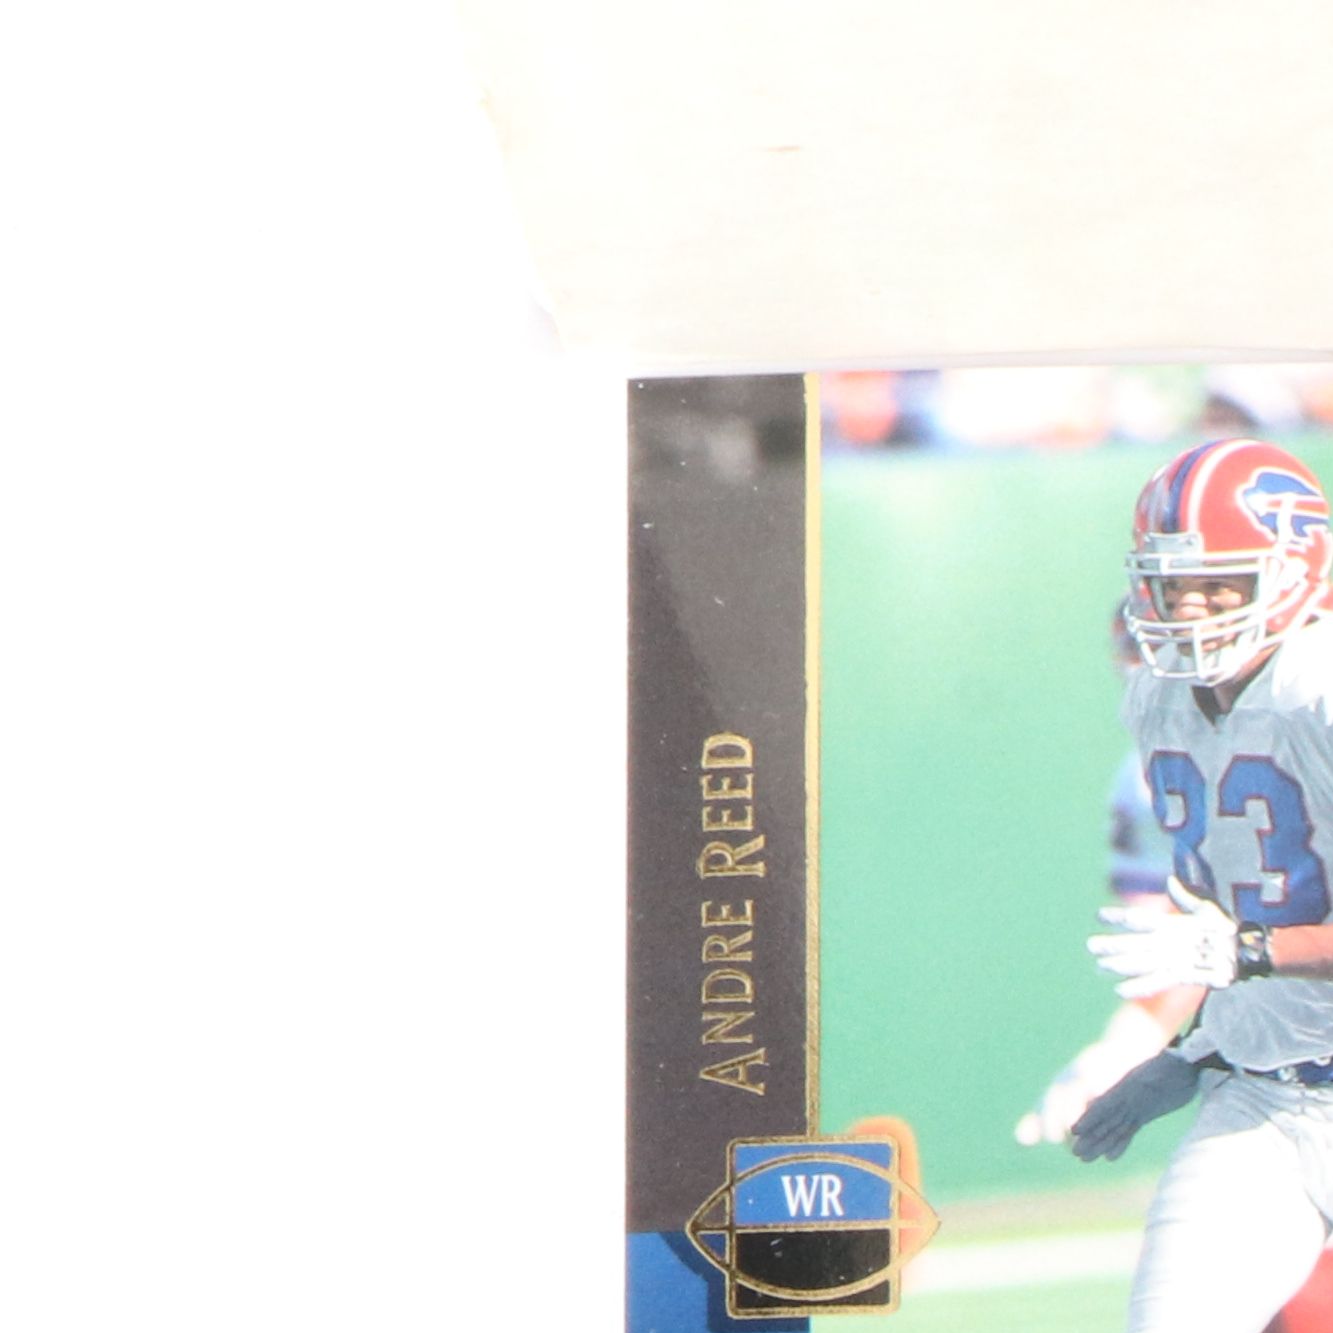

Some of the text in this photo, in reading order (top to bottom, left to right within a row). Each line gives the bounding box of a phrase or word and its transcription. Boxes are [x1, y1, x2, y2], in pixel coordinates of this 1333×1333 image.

[697, 730, 766, 1097] ANDRE REED
[780, 1173, 846, 1217] WR
